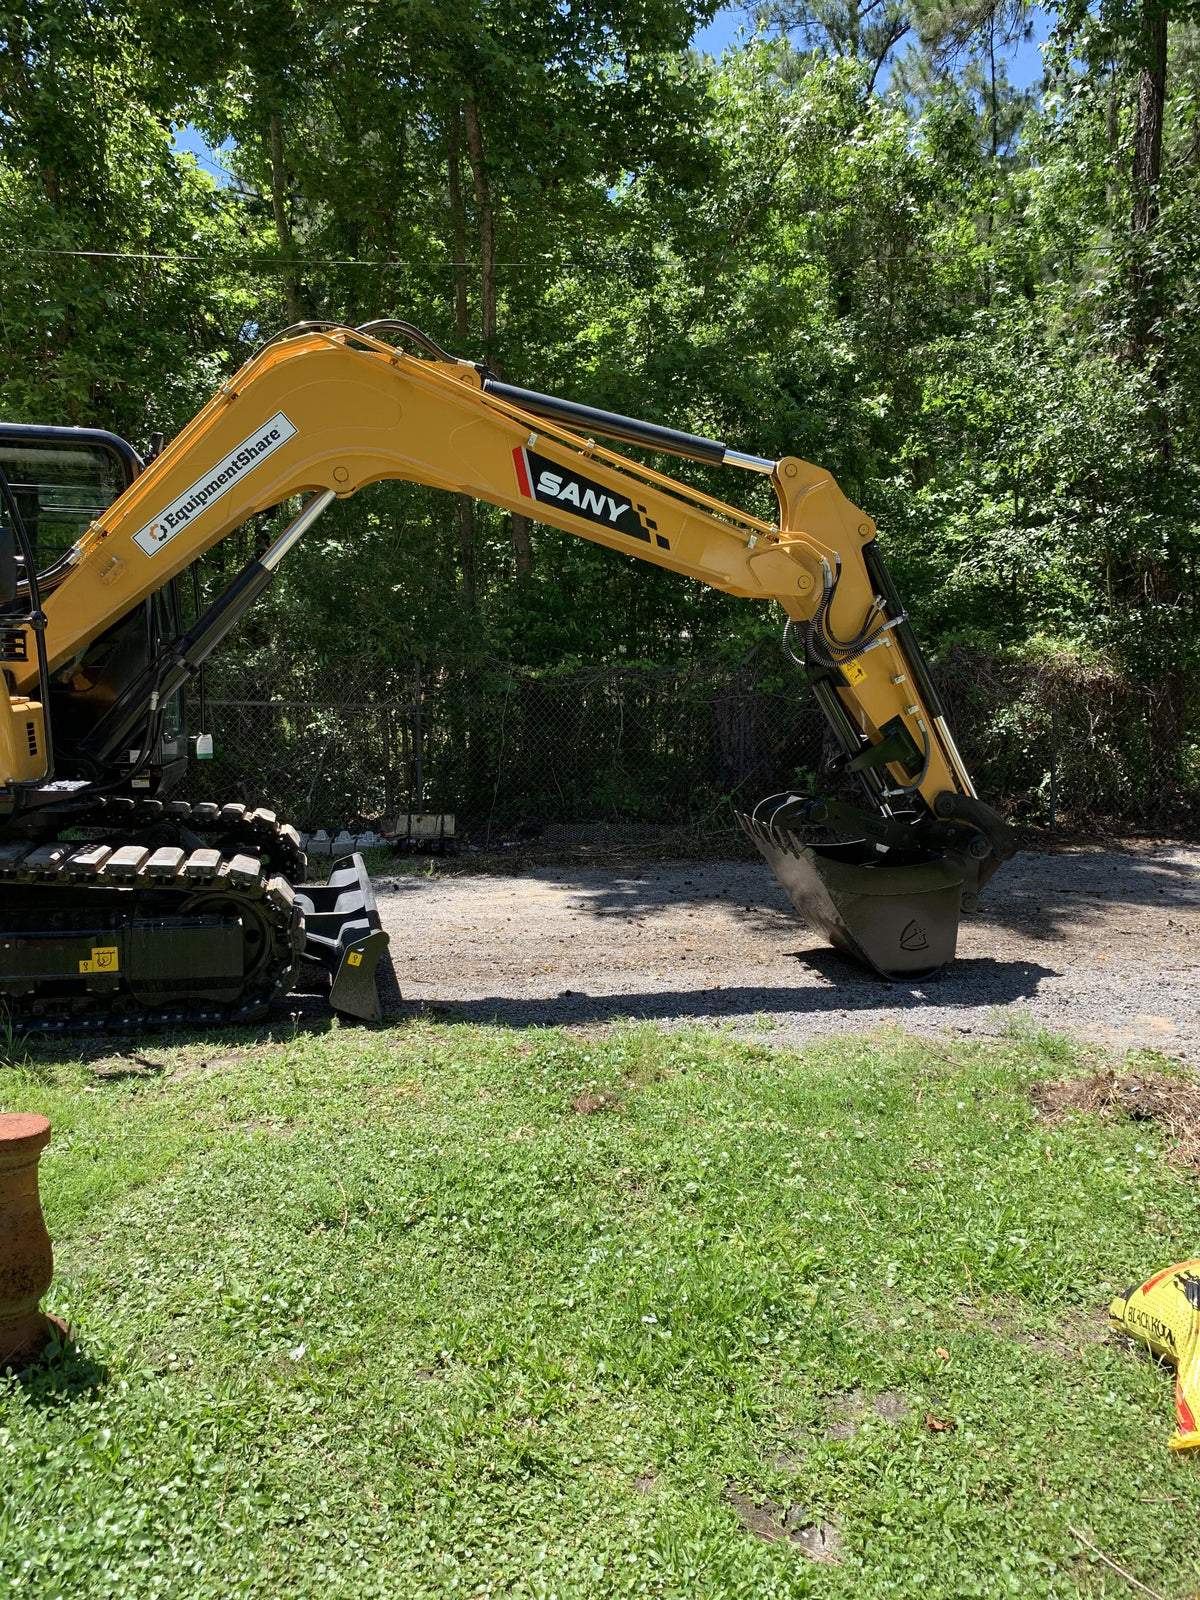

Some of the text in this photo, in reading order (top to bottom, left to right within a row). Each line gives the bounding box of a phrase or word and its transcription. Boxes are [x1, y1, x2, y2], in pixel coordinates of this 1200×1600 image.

[164, 429, 281, 529] EquipmentShare
[537, 471, 630, 522] SANY
[1128, 1306, 1151, 1331] BLACK
